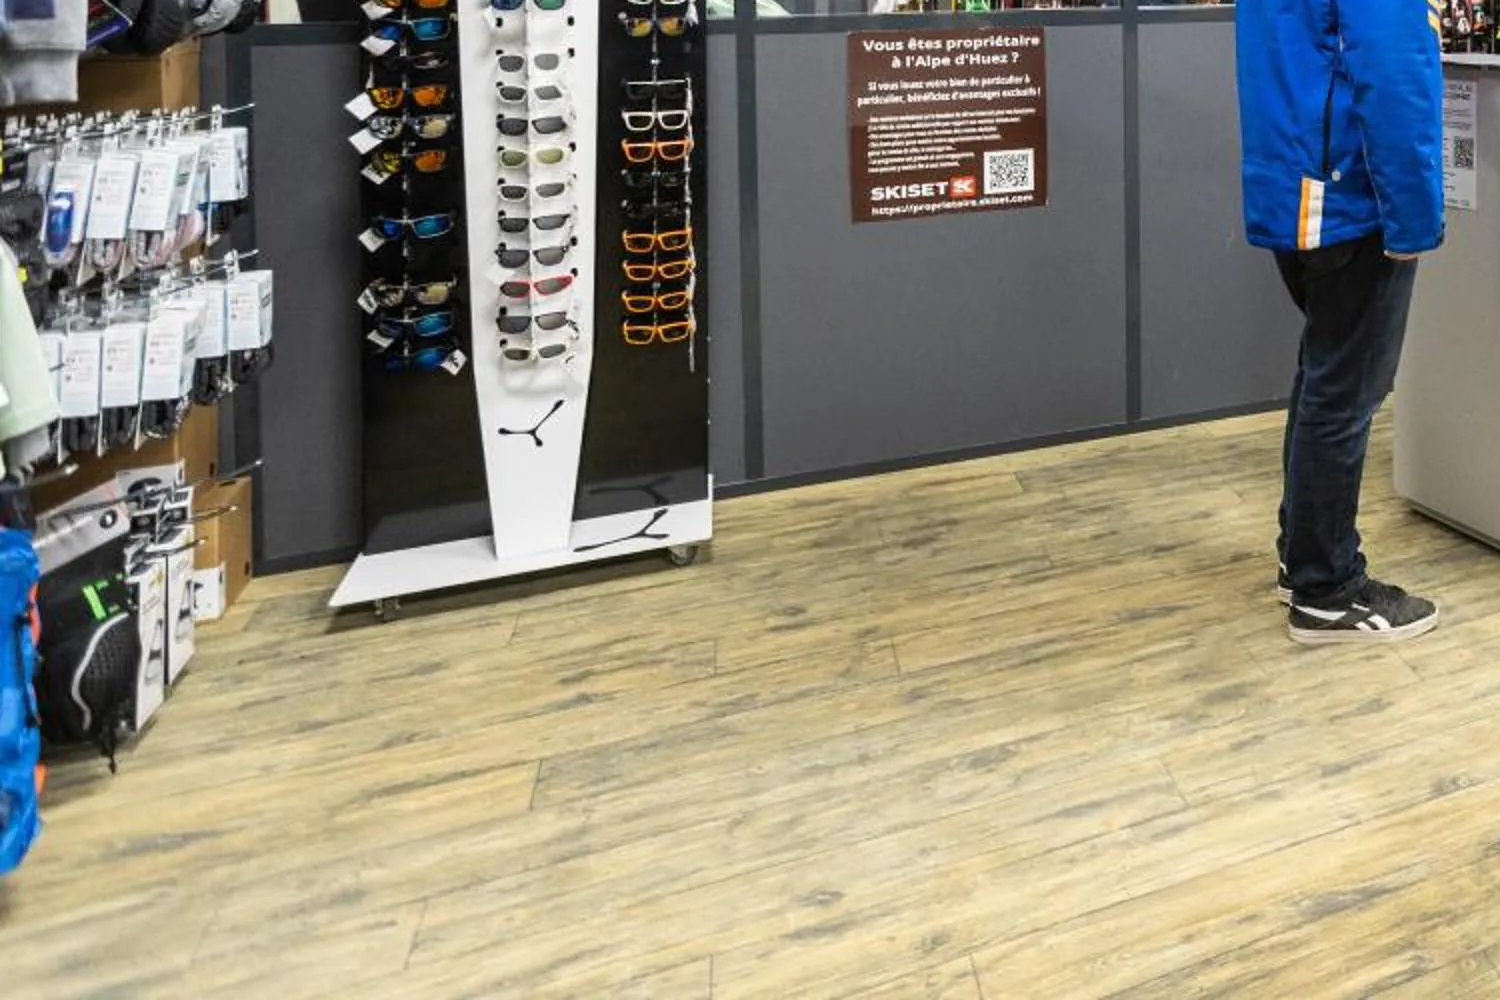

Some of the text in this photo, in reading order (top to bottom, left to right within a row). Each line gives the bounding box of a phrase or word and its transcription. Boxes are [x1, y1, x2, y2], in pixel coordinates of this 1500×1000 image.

[863, 34, 1041, 52] Vous êtes propriétaire
[891, 51, 1020, 69] à l'Alpe d'Huez ?
[981, 74, 1024, 88] particulier
[870, 181, 949, 201] SKISET
